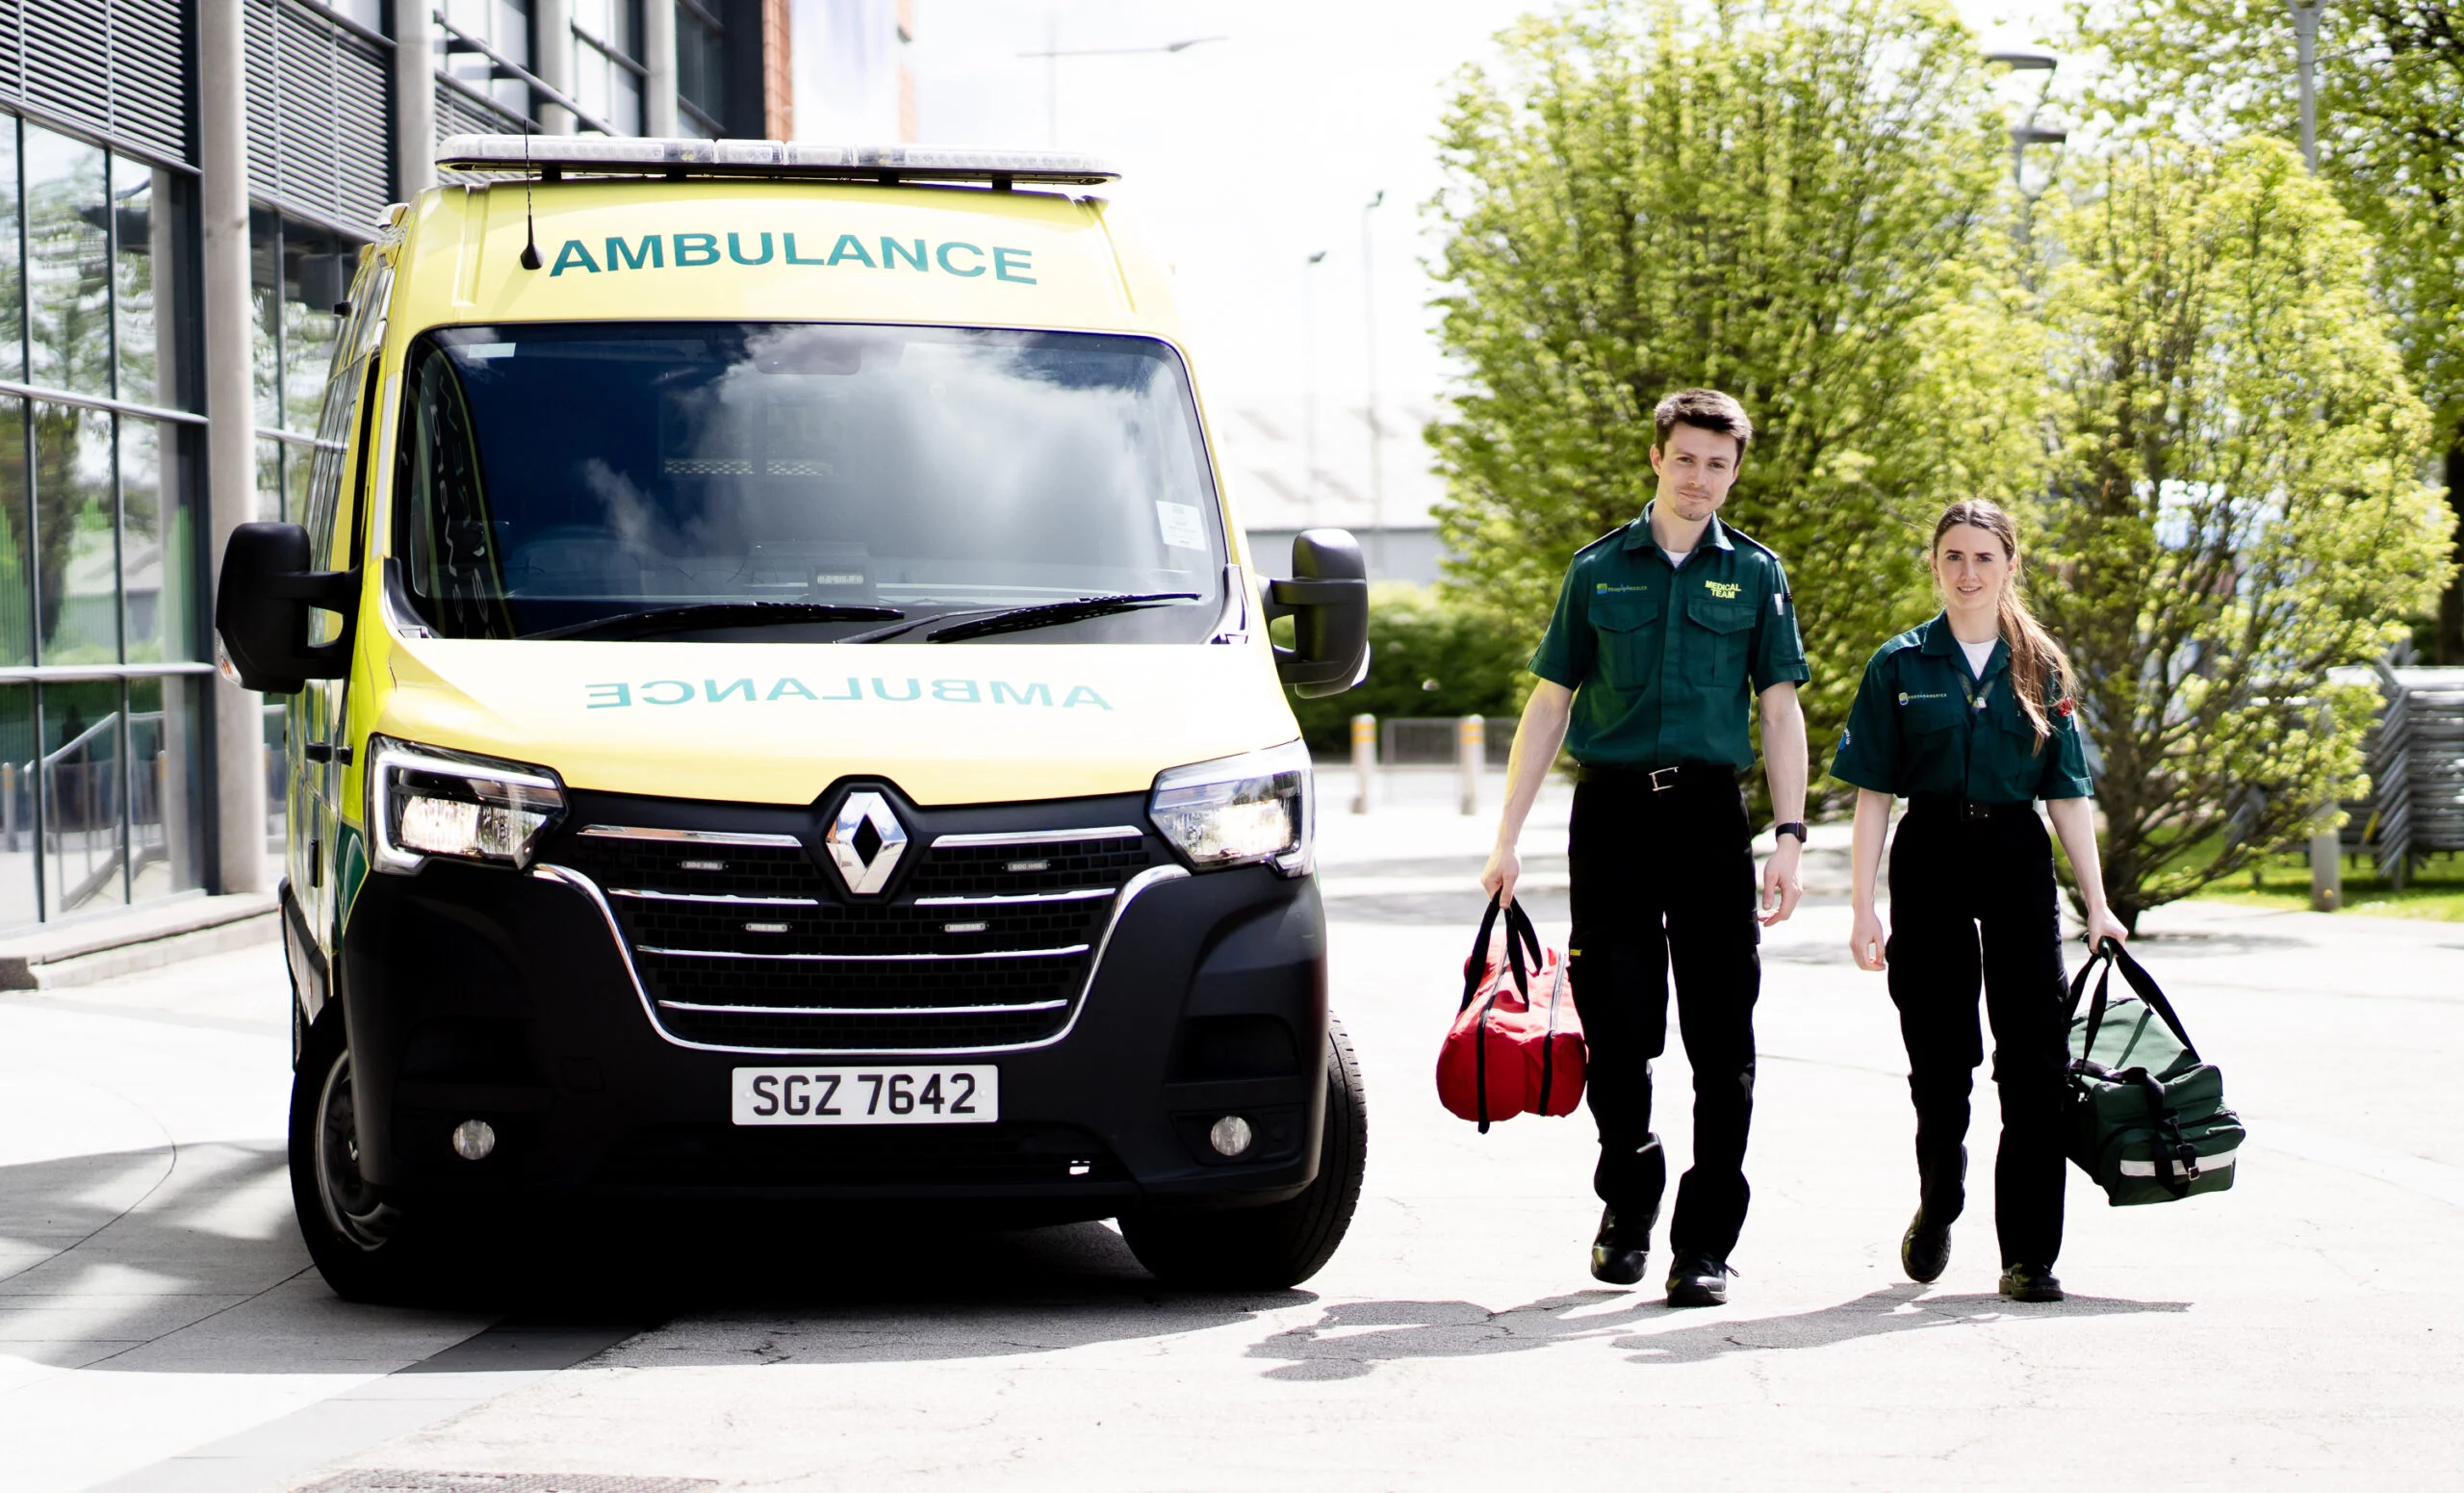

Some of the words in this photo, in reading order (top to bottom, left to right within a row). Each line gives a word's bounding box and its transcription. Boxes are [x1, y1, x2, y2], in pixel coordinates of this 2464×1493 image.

[549, 231, 1038, 285] AMBULANCE
[1705, 579, 1742, 592] MEDICAL
[1710, 588, 1735, 599] TEAM
[753, 1074, 841, 1116] SGZ
[858, 1072, 976, 1115] 7642
